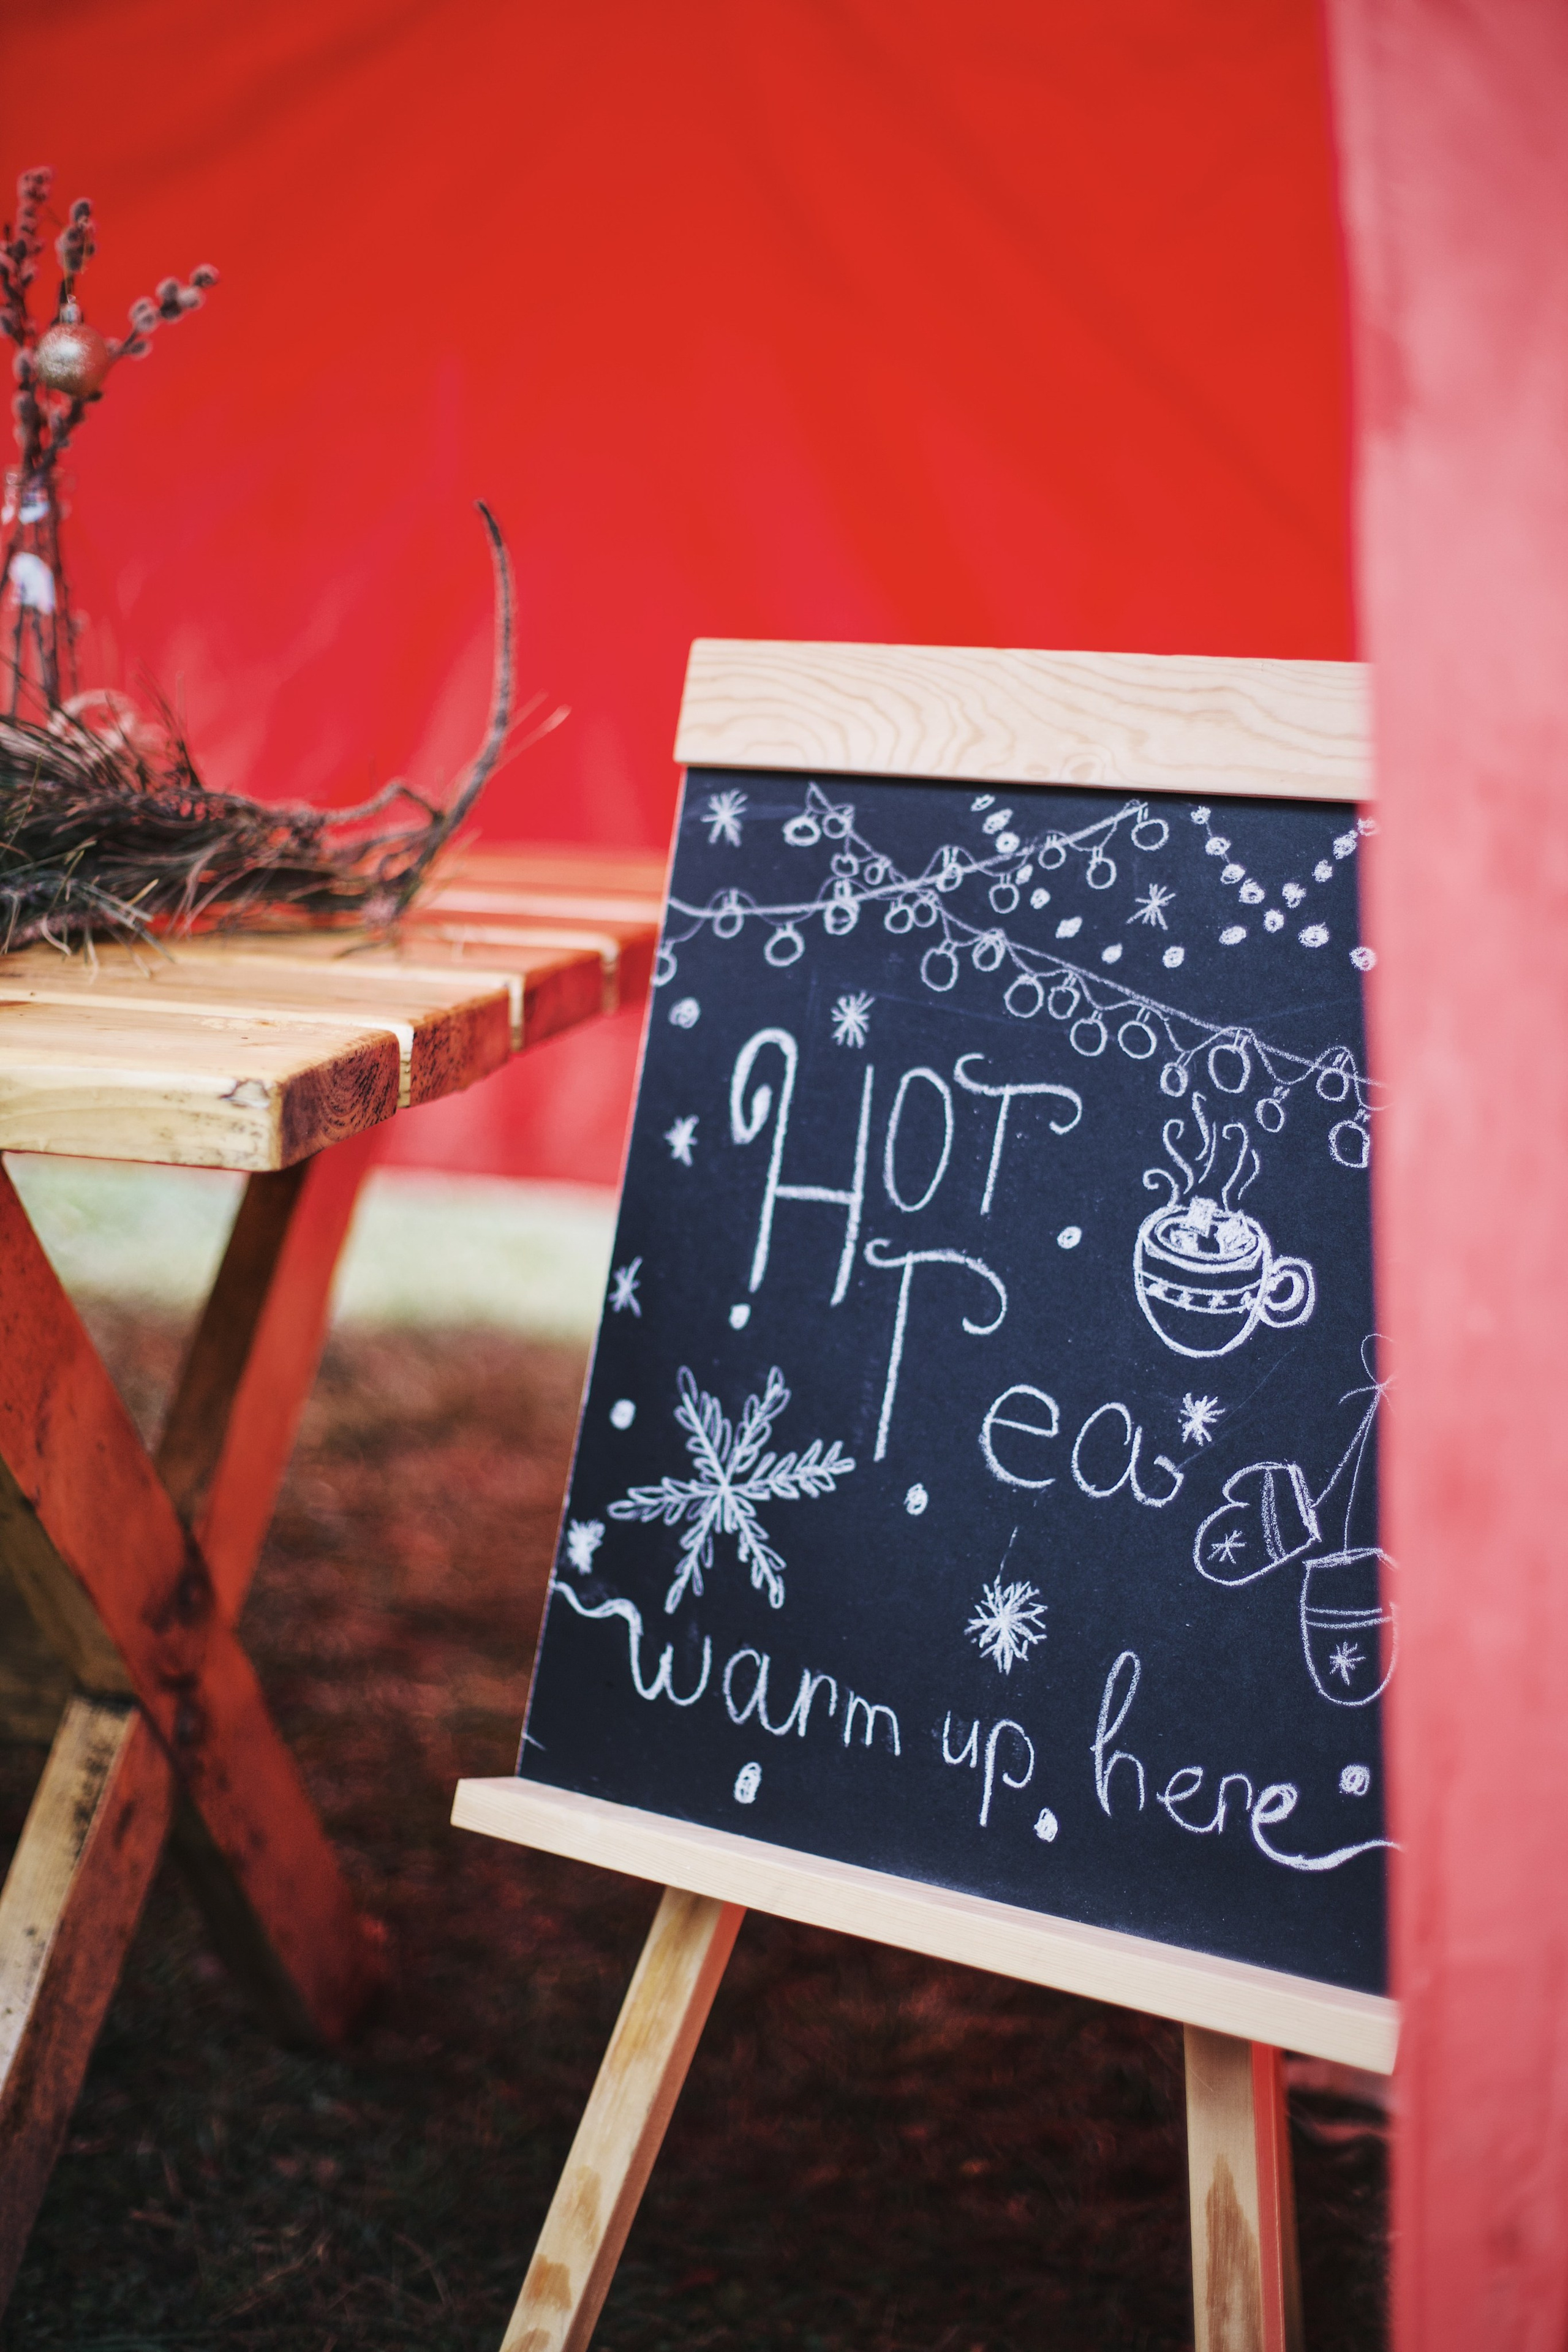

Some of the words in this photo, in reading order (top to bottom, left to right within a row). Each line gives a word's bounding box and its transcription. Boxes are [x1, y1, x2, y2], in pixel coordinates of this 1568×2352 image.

[731, 1027, 1083, 1306] HOT
[864, 1238, 1184, 1507] Tea
[1090, 1650, 1401, 1871] here
